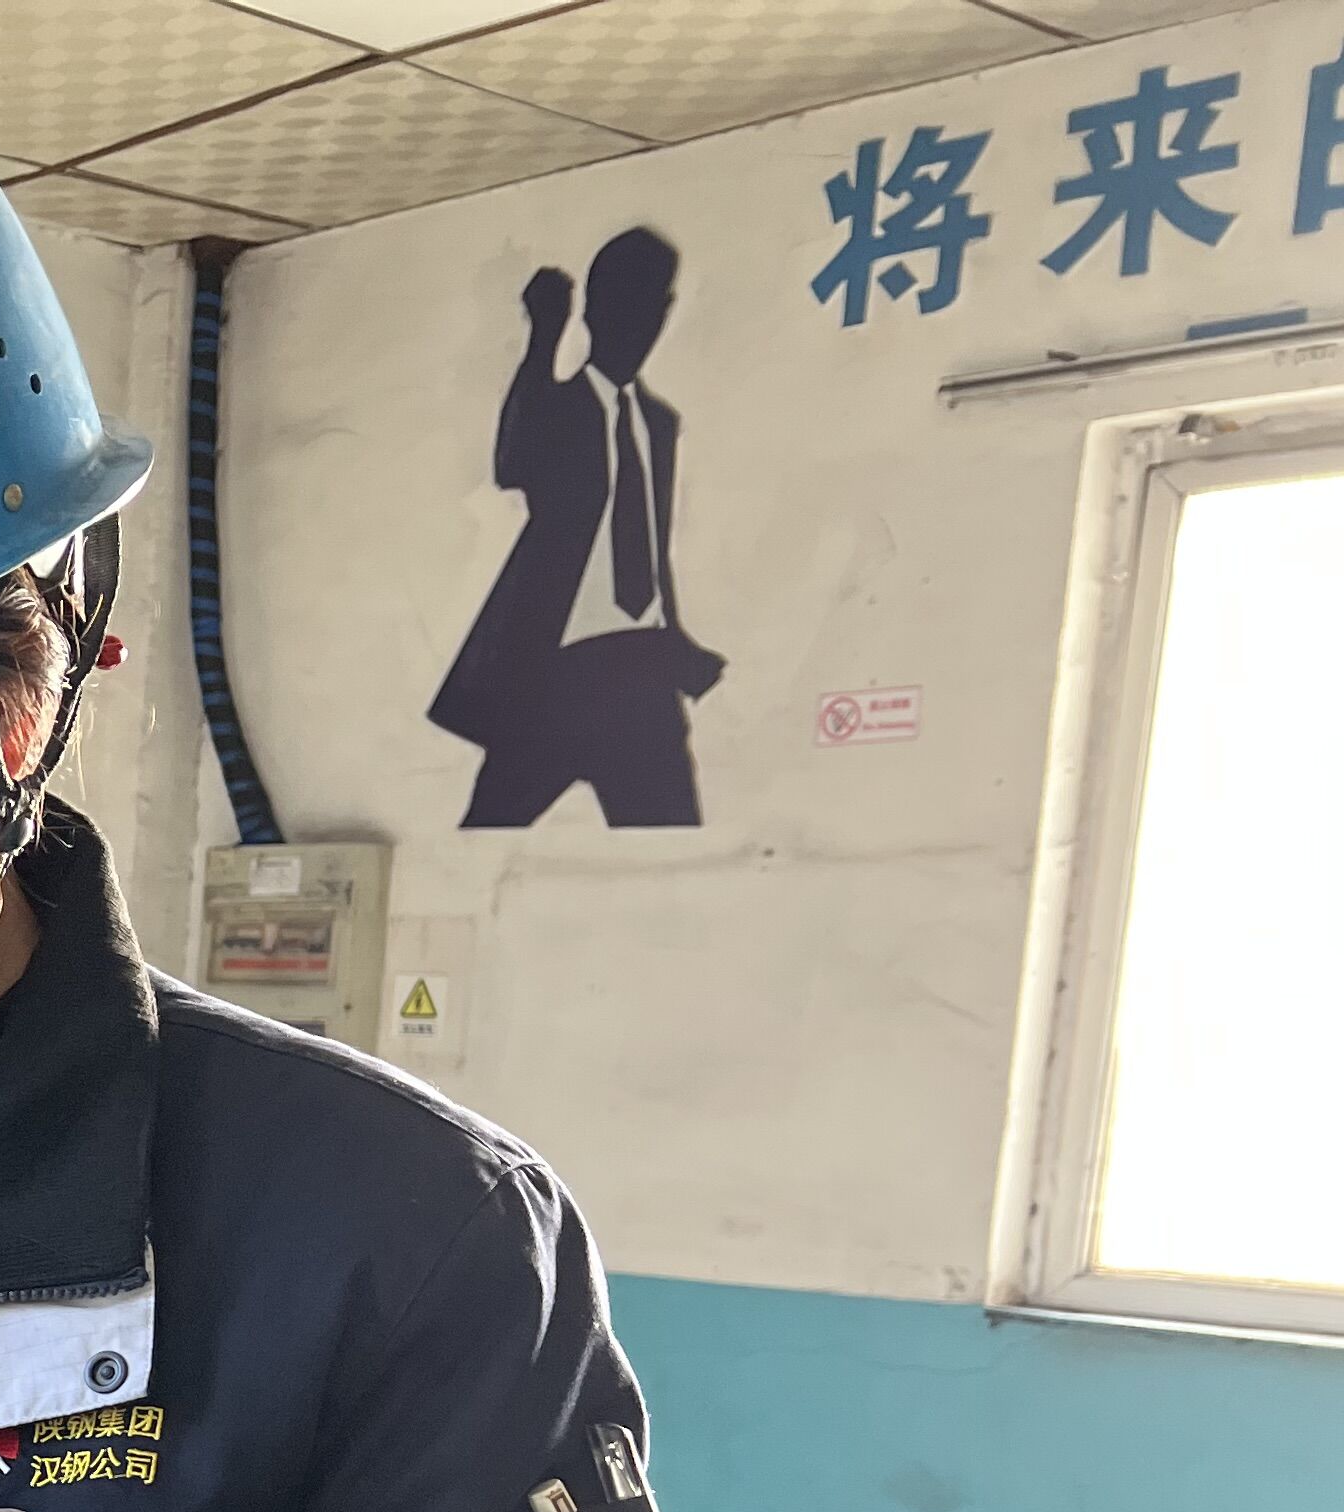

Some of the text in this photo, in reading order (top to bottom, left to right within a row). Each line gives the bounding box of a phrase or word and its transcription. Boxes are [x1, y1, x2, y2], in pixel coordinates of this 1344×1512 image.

[33, 1405, 164, 1444] 陕钢集团
[29, 1446, 158, 1487] 汉钢公司
